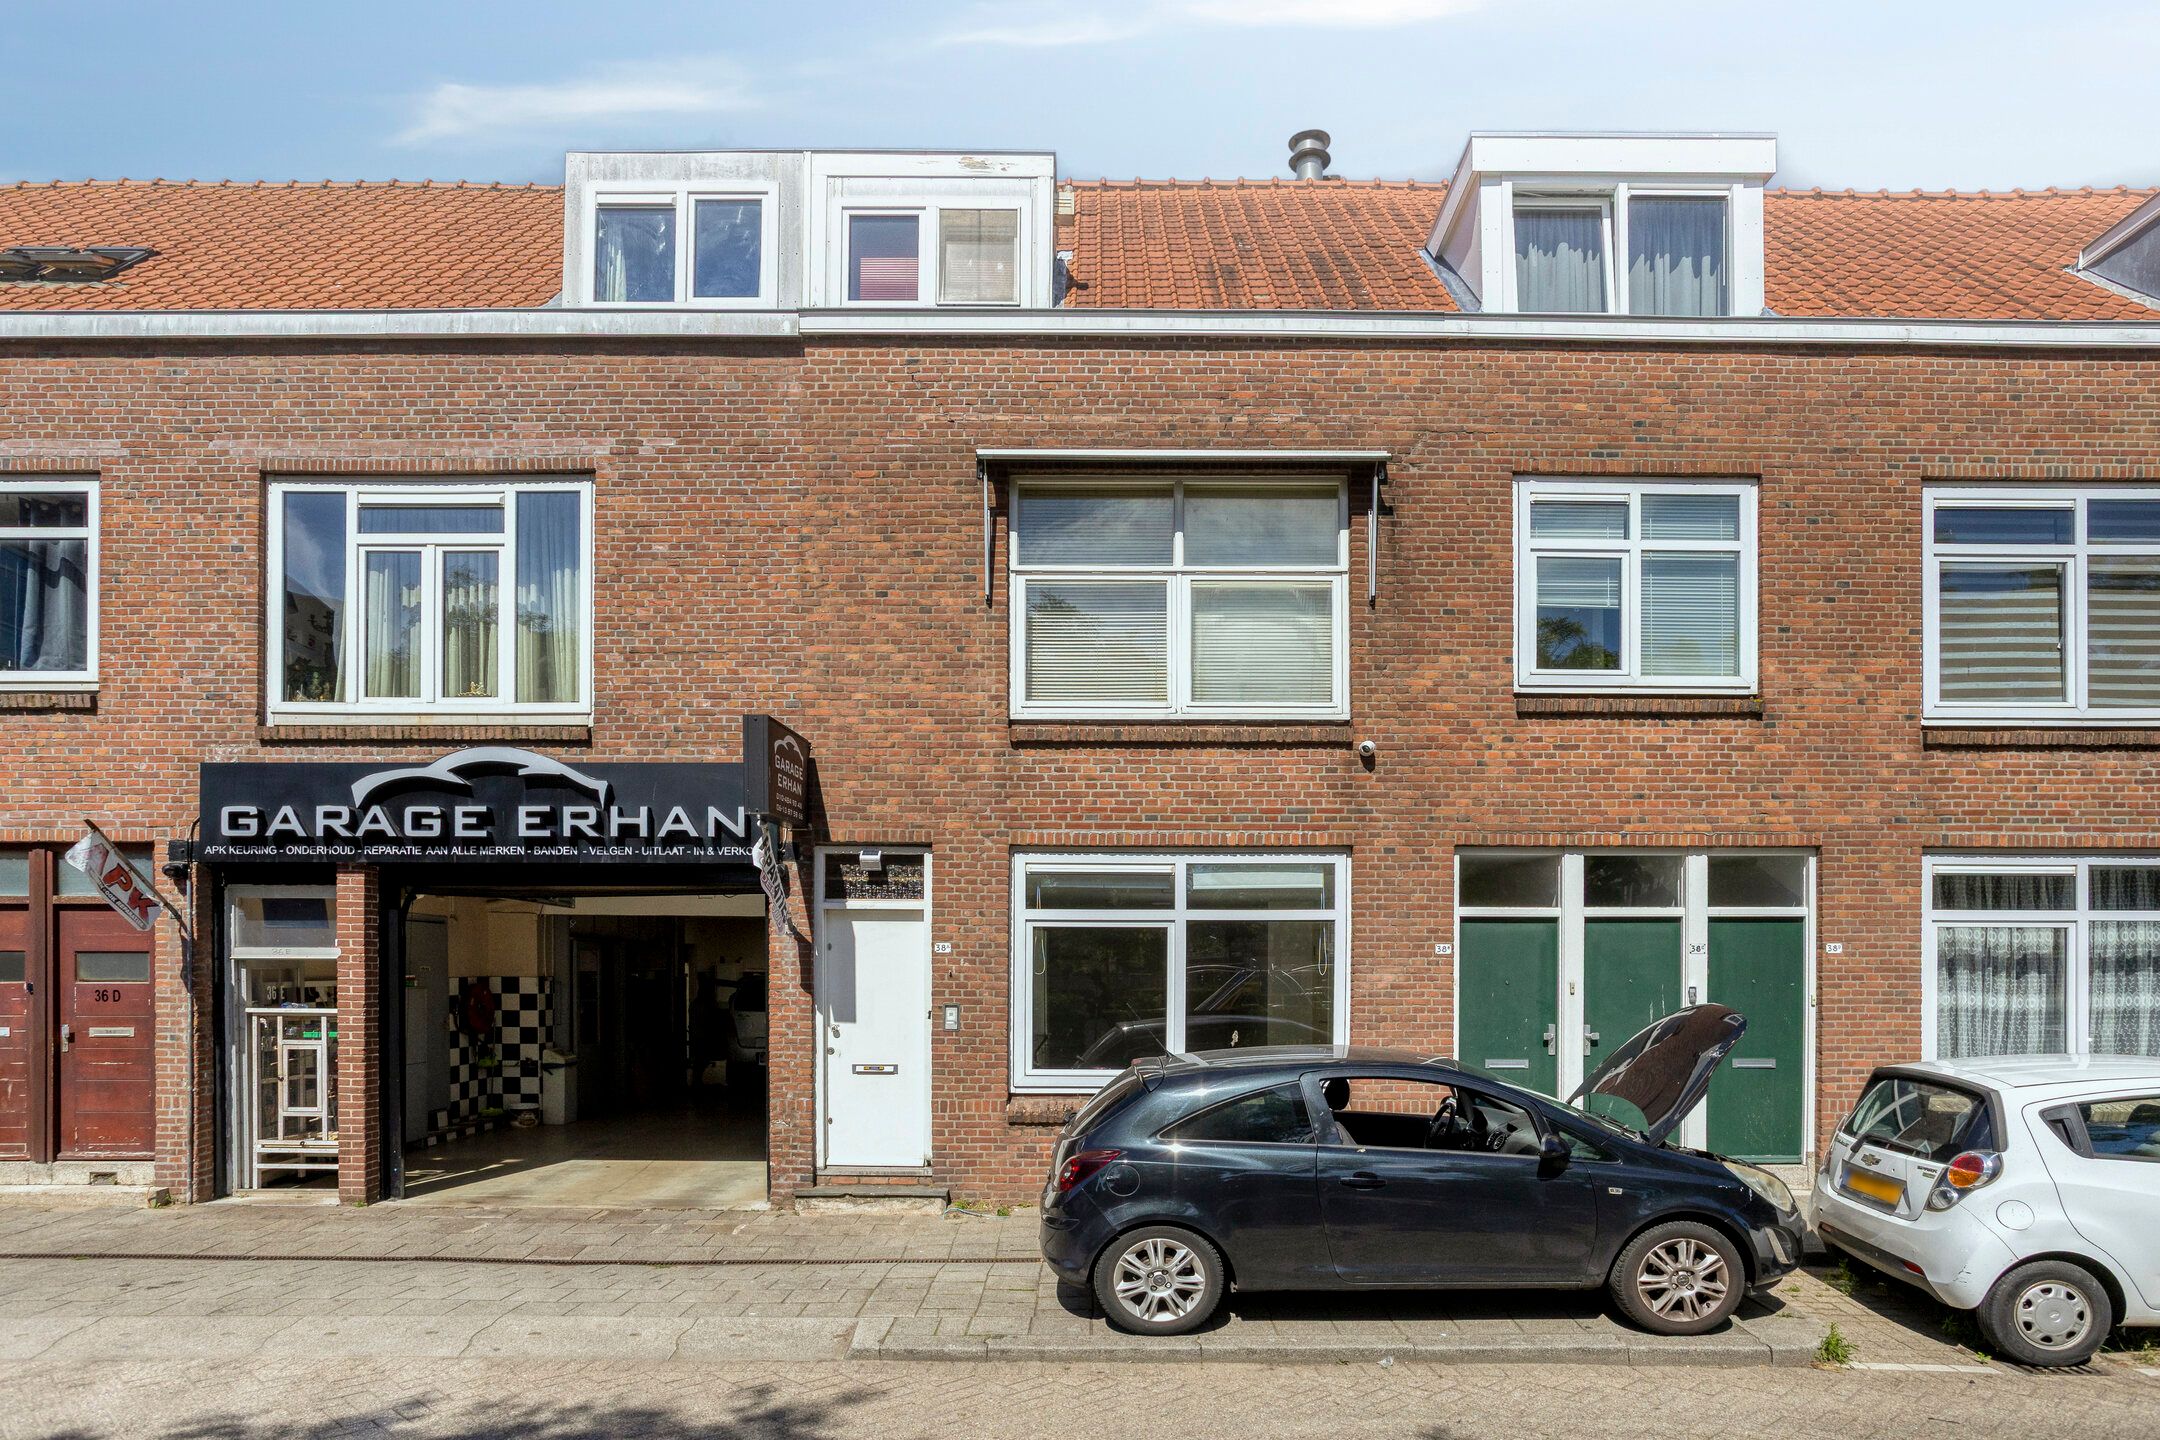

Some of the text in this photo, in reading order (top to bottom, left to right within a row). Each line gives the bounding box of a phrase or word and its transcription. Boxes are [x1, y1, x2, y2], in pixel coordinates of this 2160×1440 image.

[775, 754, 804, 781] GARAGE
[777, 773, 803, 797] ERHAN
[220, 805, 746, 838] GARAGE ERHAN
[204, 845, 227, 855] APK
[229, 845, 277, 855] KEURING
[286, 845, 355, 855] ONDERHOUD
[364, 845, 422, 855] REPARATIE
[426, 845, 448, 855] AAN
[451, 845, 477, 855] ALLE
[480, 846, 524, 856] MERKEN
[534, 846, 577, 856] BANDEN
[589, 846, 632, 856] VELGEN
[641, 846, 685, 856] UITLAAT
[694, 846, 705, 856] IN
[707, 846, 715, 856] &
[94, 989, 121, 1002] 36 D
[266, 986, 285, 1000] 36 E
